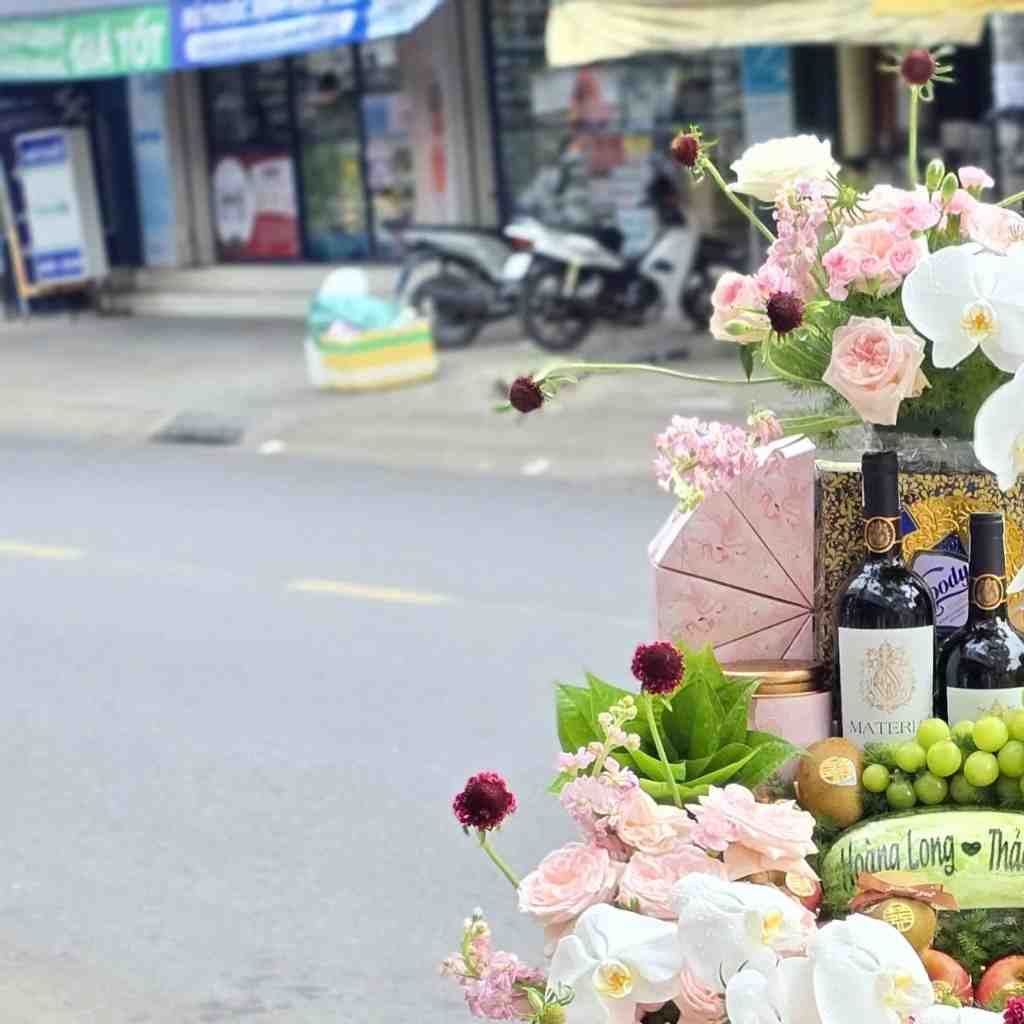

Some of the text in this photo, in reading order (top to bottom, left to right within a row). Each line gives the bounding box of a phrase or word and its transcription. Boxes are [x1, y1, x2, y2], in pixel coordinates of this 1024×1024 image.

[922, 564, 968, 602] oody
[847, 719, 916, 737] MATERI
[840, 837, 901, 875] Hoàng
[907, 828, 957, 877] Long
